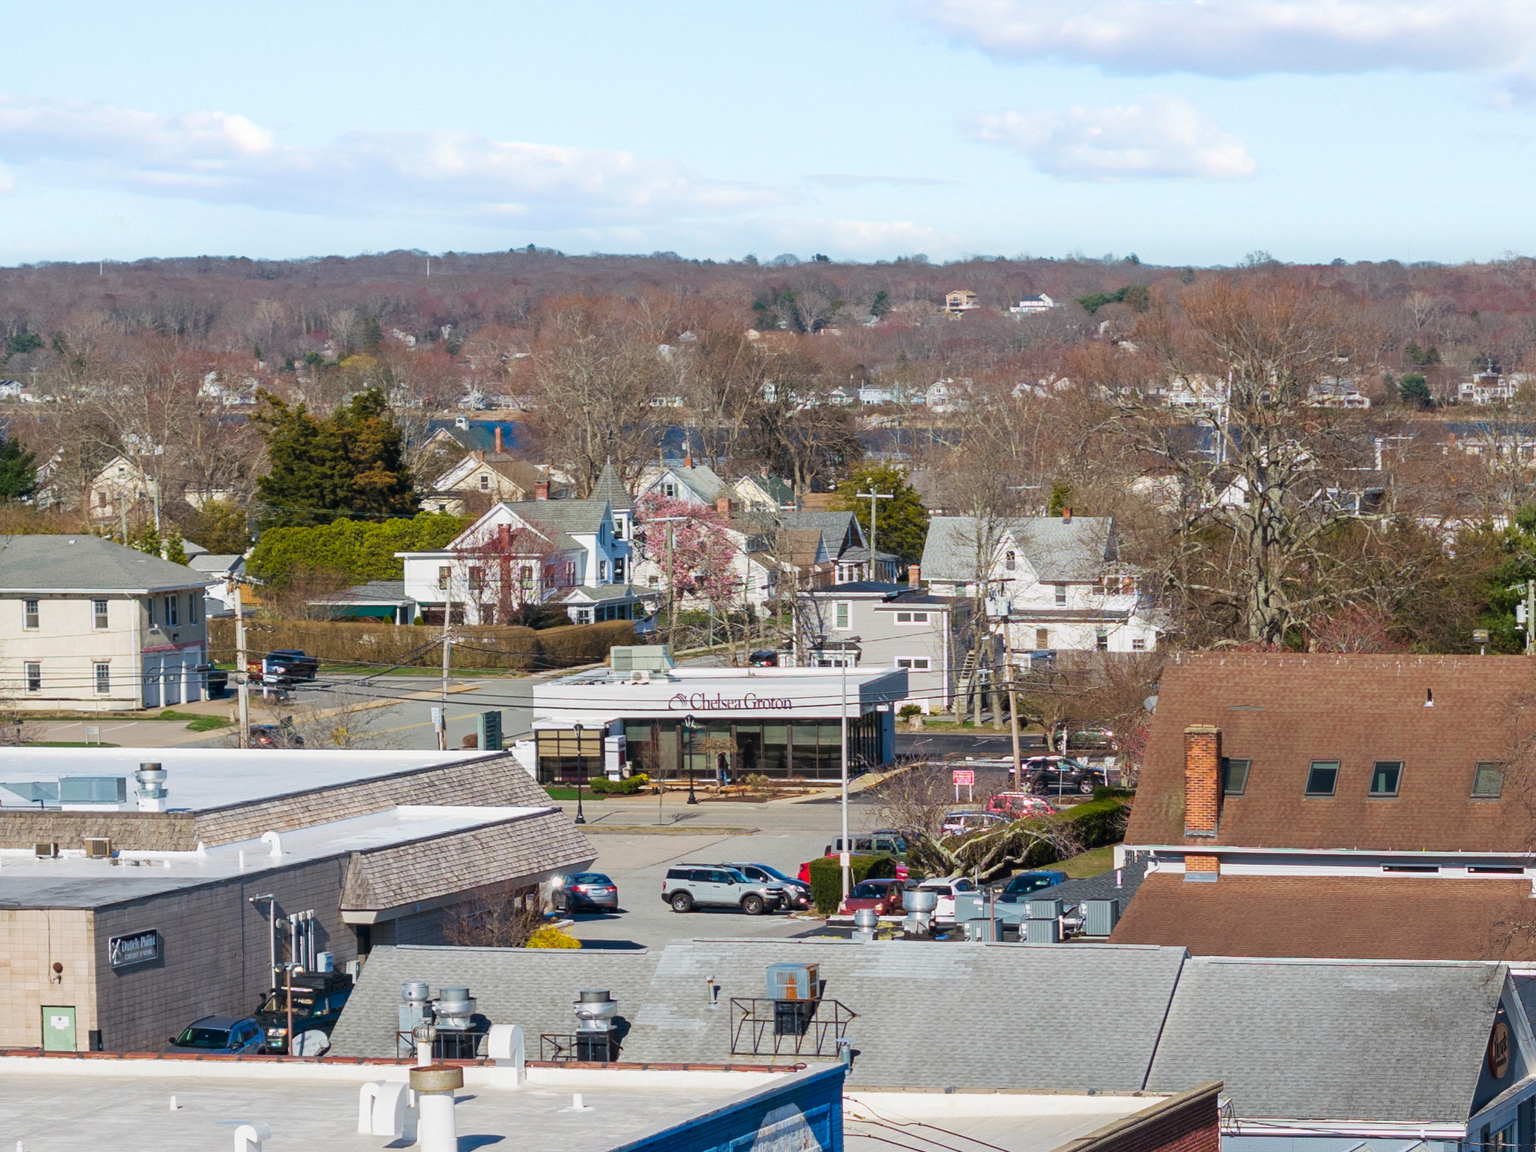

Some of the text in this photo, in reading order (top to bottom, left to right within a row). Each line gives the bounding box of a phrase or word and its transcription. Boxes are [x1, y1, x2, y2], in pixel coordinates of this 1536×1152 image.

[690, 692, 792, 710] Chelsea Groton
[121, 934, 156, 953] Dutch Point
